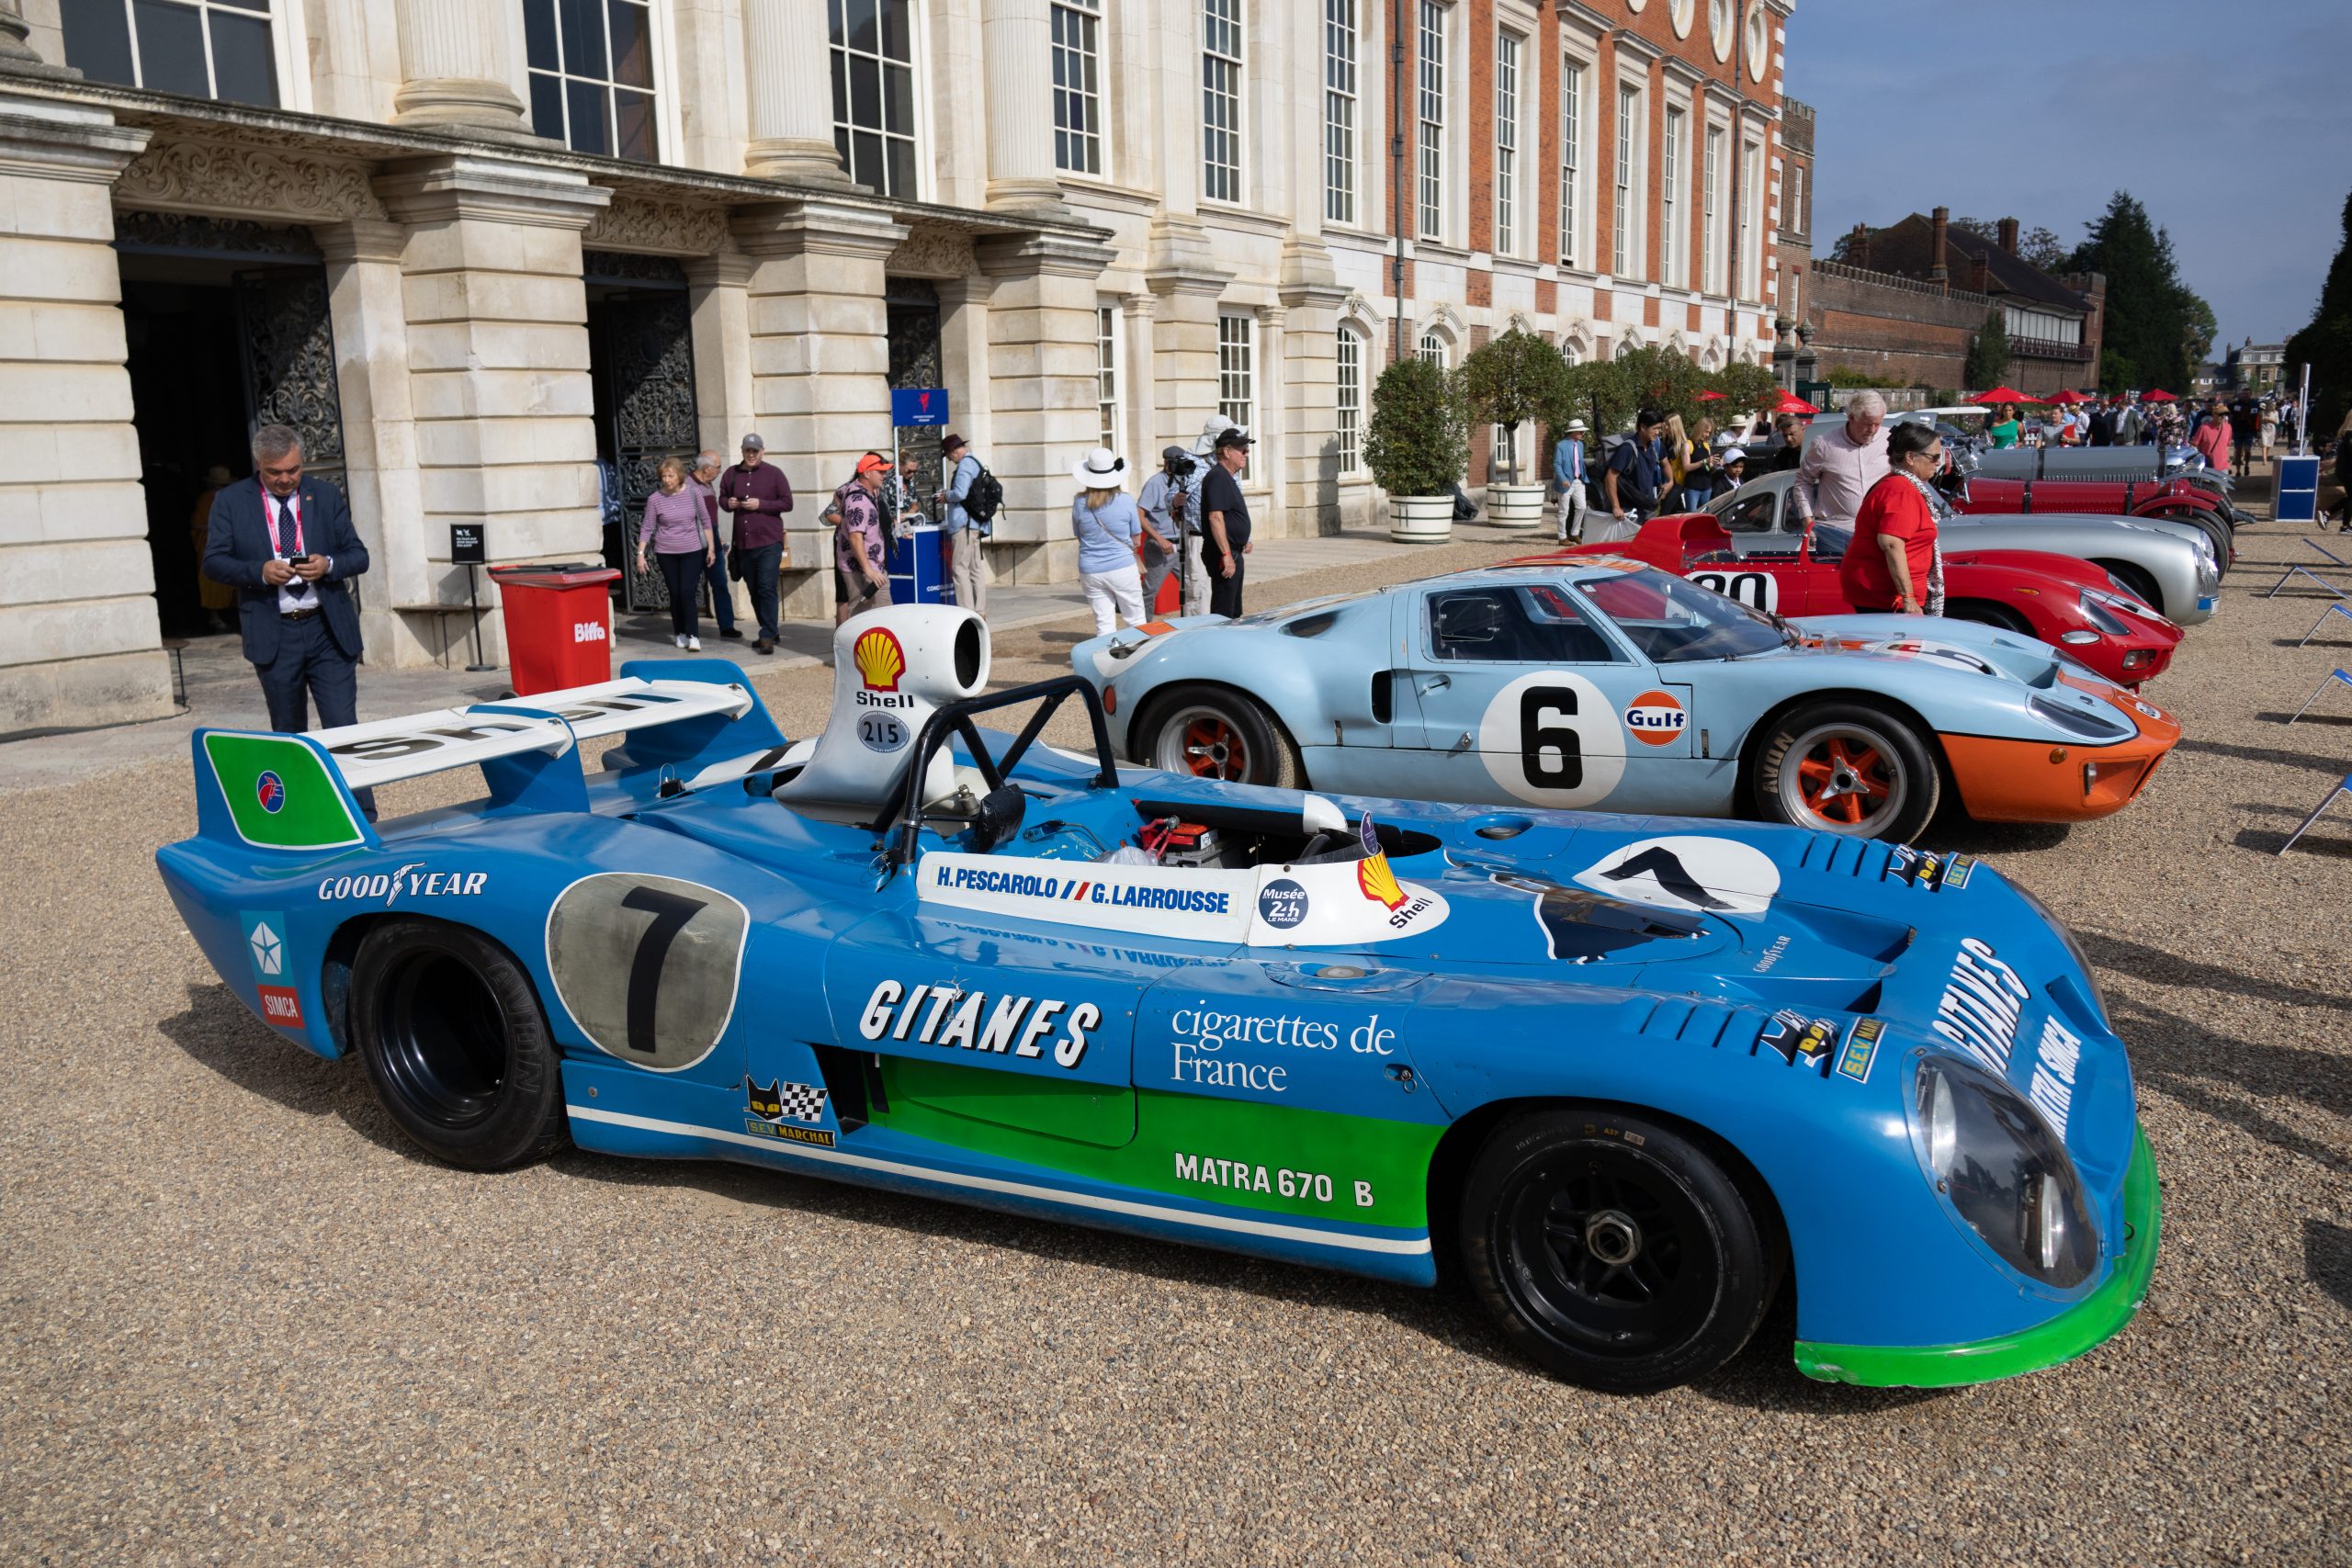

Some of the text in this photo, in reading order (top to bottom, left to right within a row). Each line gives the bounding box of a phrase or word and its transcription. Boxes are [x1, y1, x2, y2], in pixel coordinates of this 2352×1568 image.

[574, 621, 605, 642] Biffa
[856, 691, 914, 708] Shell
[1626, 709, 1685, 728] Gulf
[863, 721, 899, 744] 215
[1520, 685, 1583, 790] 6
[1762, 731, 1794, 794] AVON
[1262, 887, 1306, 900] Musée
[1598, 846, 1739, 910] 7
[1389, 897, 1433, 930] Shell
[620, 886, 709, 1054] 7
[265, 994, 299, 1019] SIMCA
[485, 961, 543, 1094] AVON
[858, 979, 1103, 1070] GITANES
[1171, 999, 1396, 1055] cigarettes de
[1931, 937, 2031, 1081] GITANES
[1170, 1042, 1287, 1092] France
[2037, 1014, 2082, 1085] SIMCA
[778, 1125, 831, 1145] MARCHAL
[1174, 1152, 1375, 1208] MATRA 670 B
